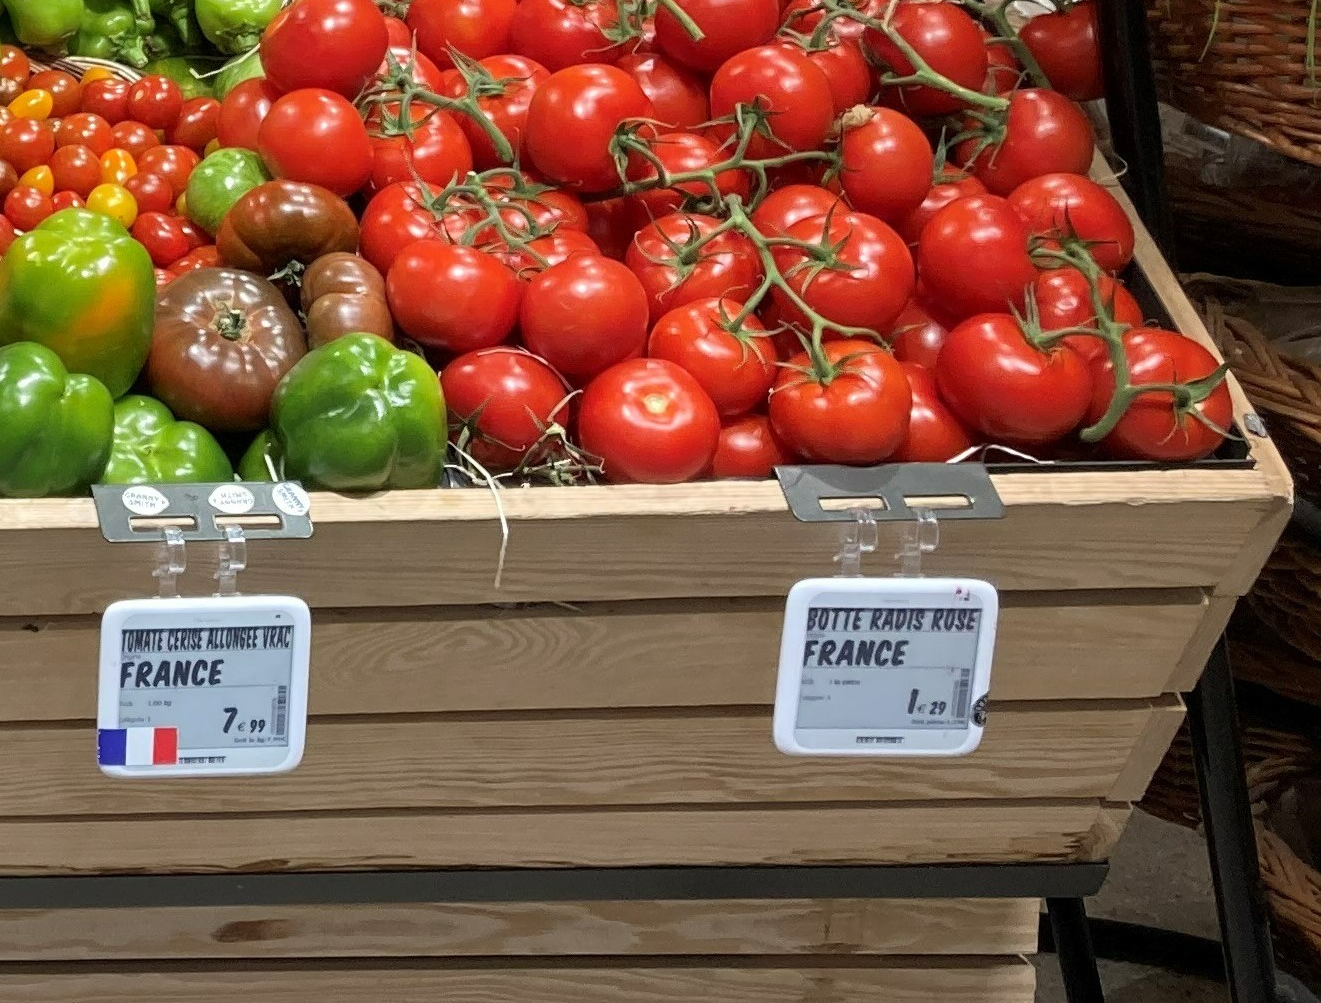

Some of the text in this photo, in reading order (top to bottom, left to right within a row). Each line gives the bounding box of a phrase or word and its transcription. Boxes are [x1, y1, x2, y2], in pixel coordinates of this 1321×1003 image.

[807, 609, 978, 631] BOTTE RADIS ROSE
[121, 625, 292, 653] TOMATE CERISE ALLONGEE VRAC
[803, 639, 910, 668] FRANCE
[120, 659, 225, 688] FRANCE
